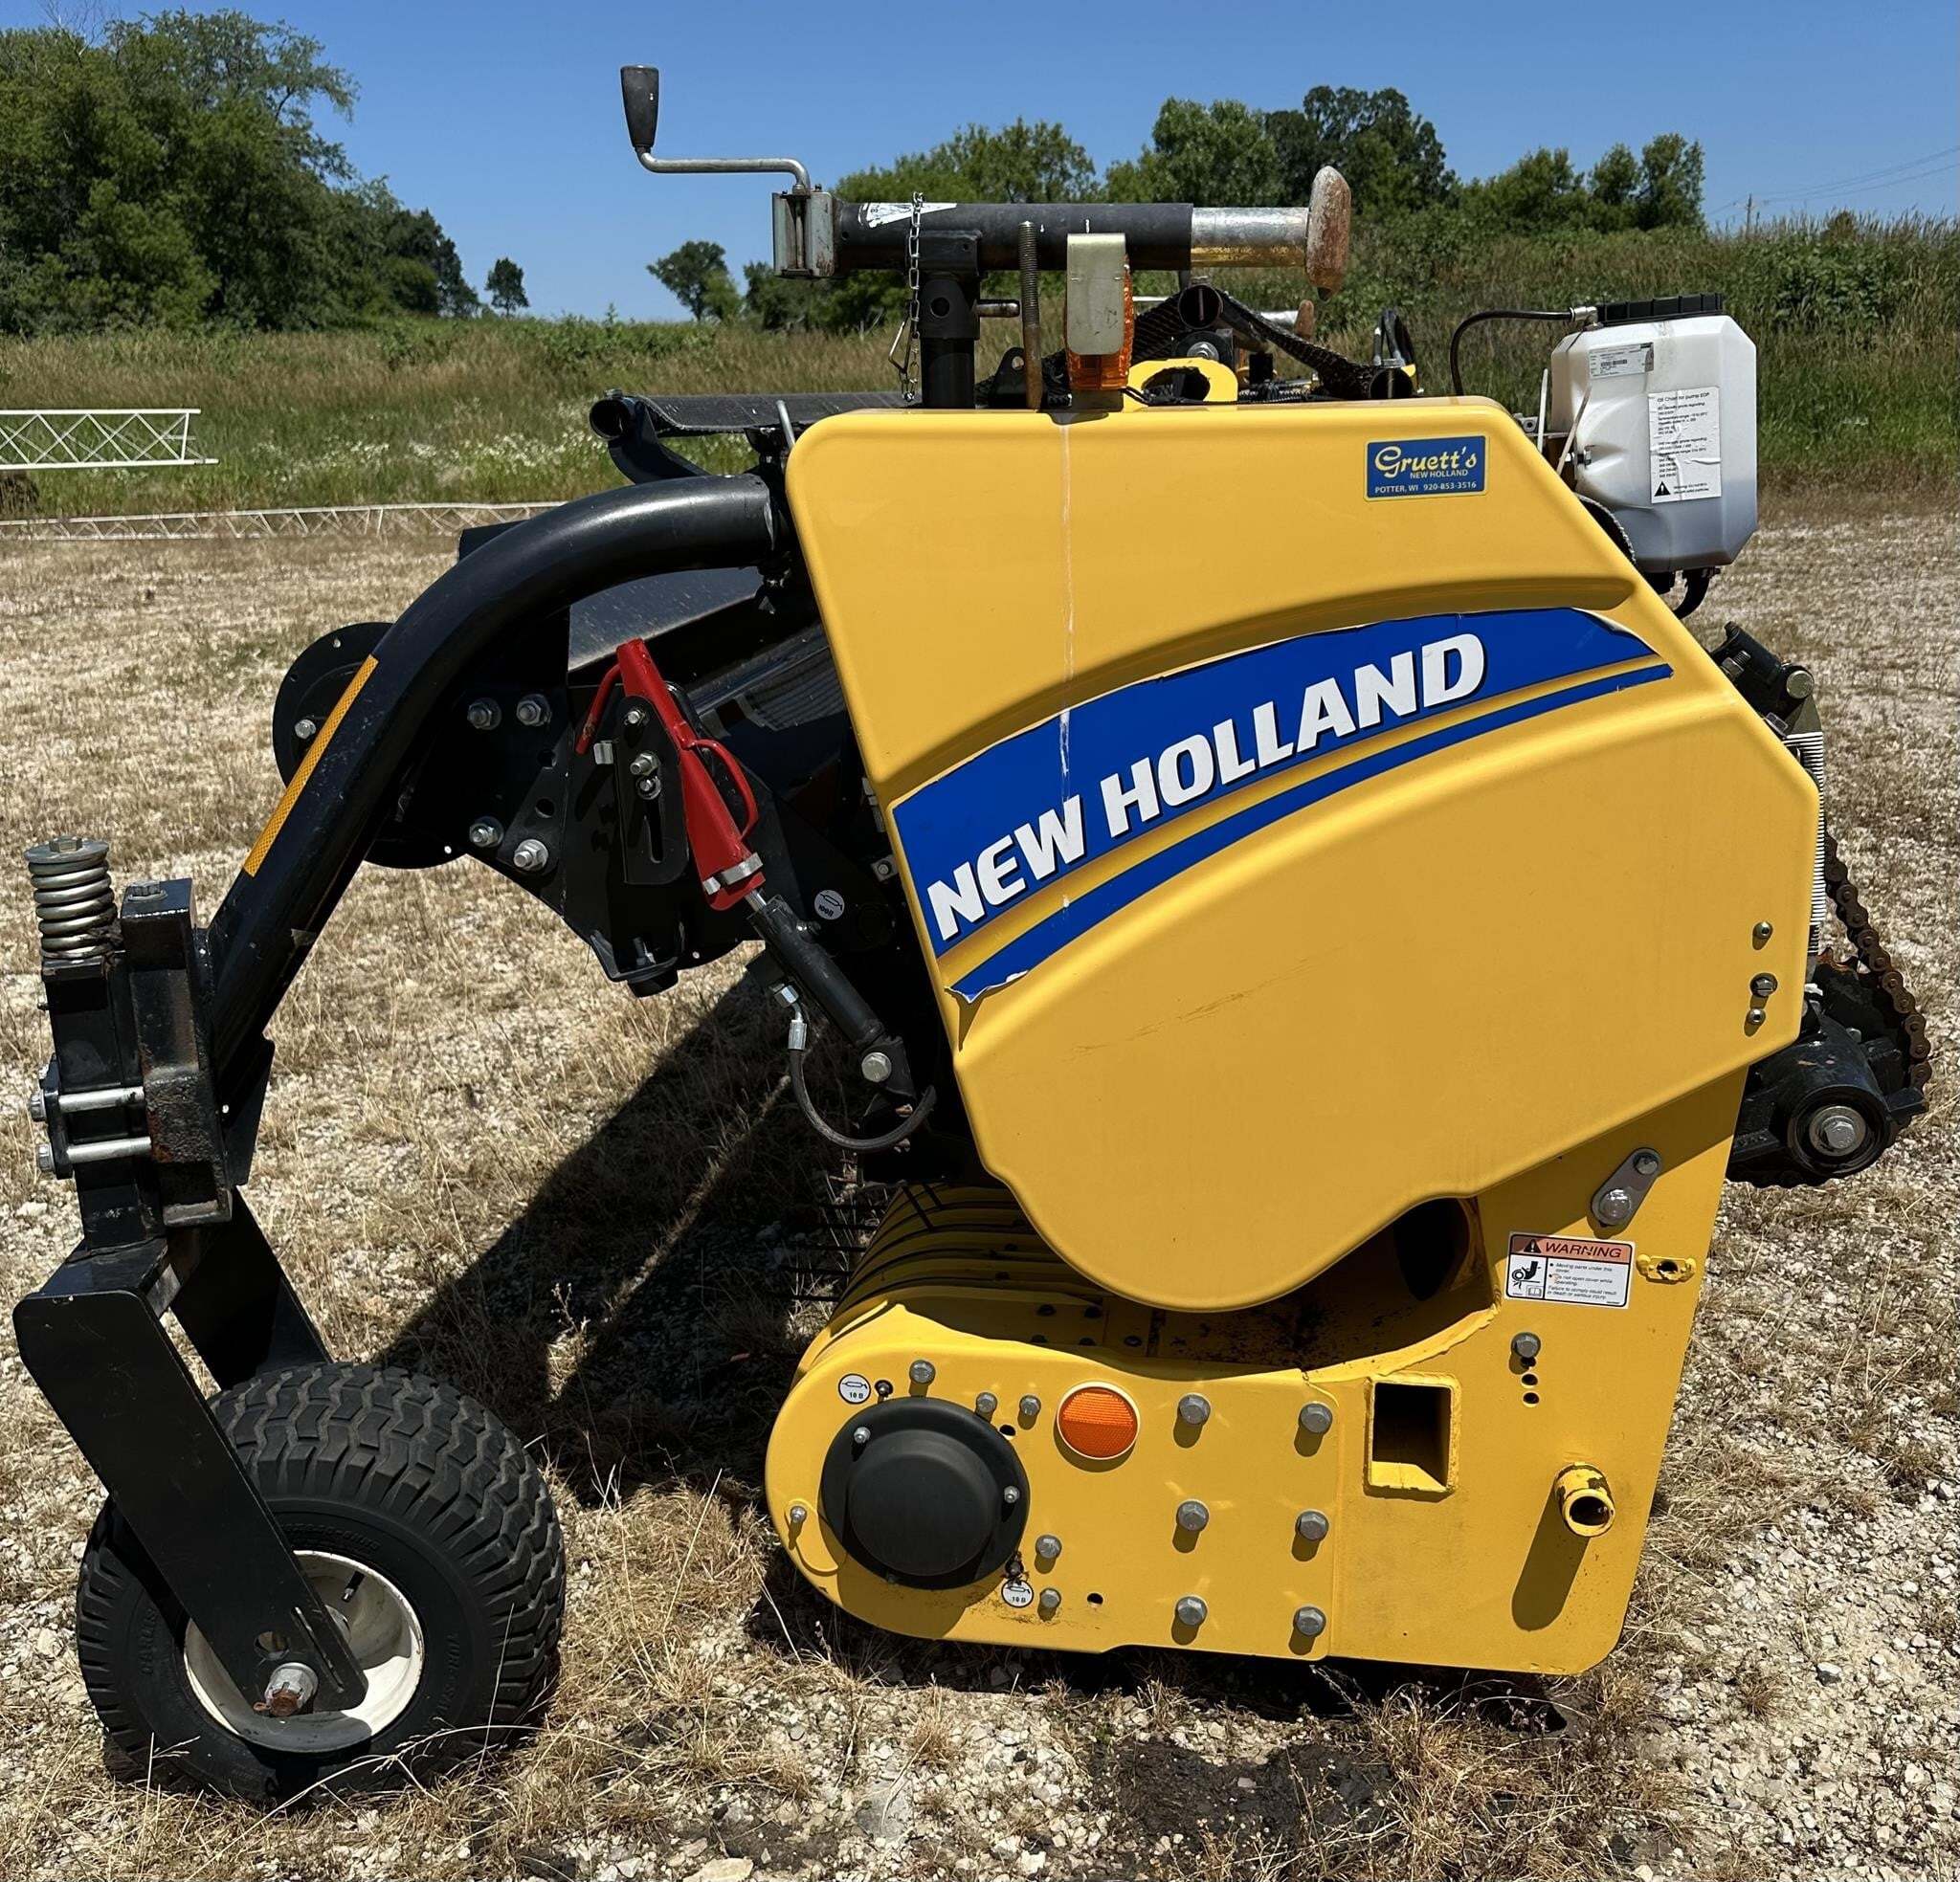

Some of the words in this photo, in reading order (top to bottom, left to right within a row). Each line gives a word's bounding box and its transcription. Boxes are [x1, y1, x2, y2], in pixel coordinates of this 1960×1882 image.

[1374, 446, 1477, 478] Gruett's
[1410, 471, 1428, 479] NEW
[1429, 469, 1468, 478] HOLLAND
[1374, 484, 1407, 494] POTTER,
[1408, 483, 1418, 492] WI
[1423, 481, 1477, 491] 920-853-3516
[926, 794, 1085, 941] NEW
[1100, 633, 1485, 839] HOLLAND
[1545, 1242, 1622, 1258] WARNING
